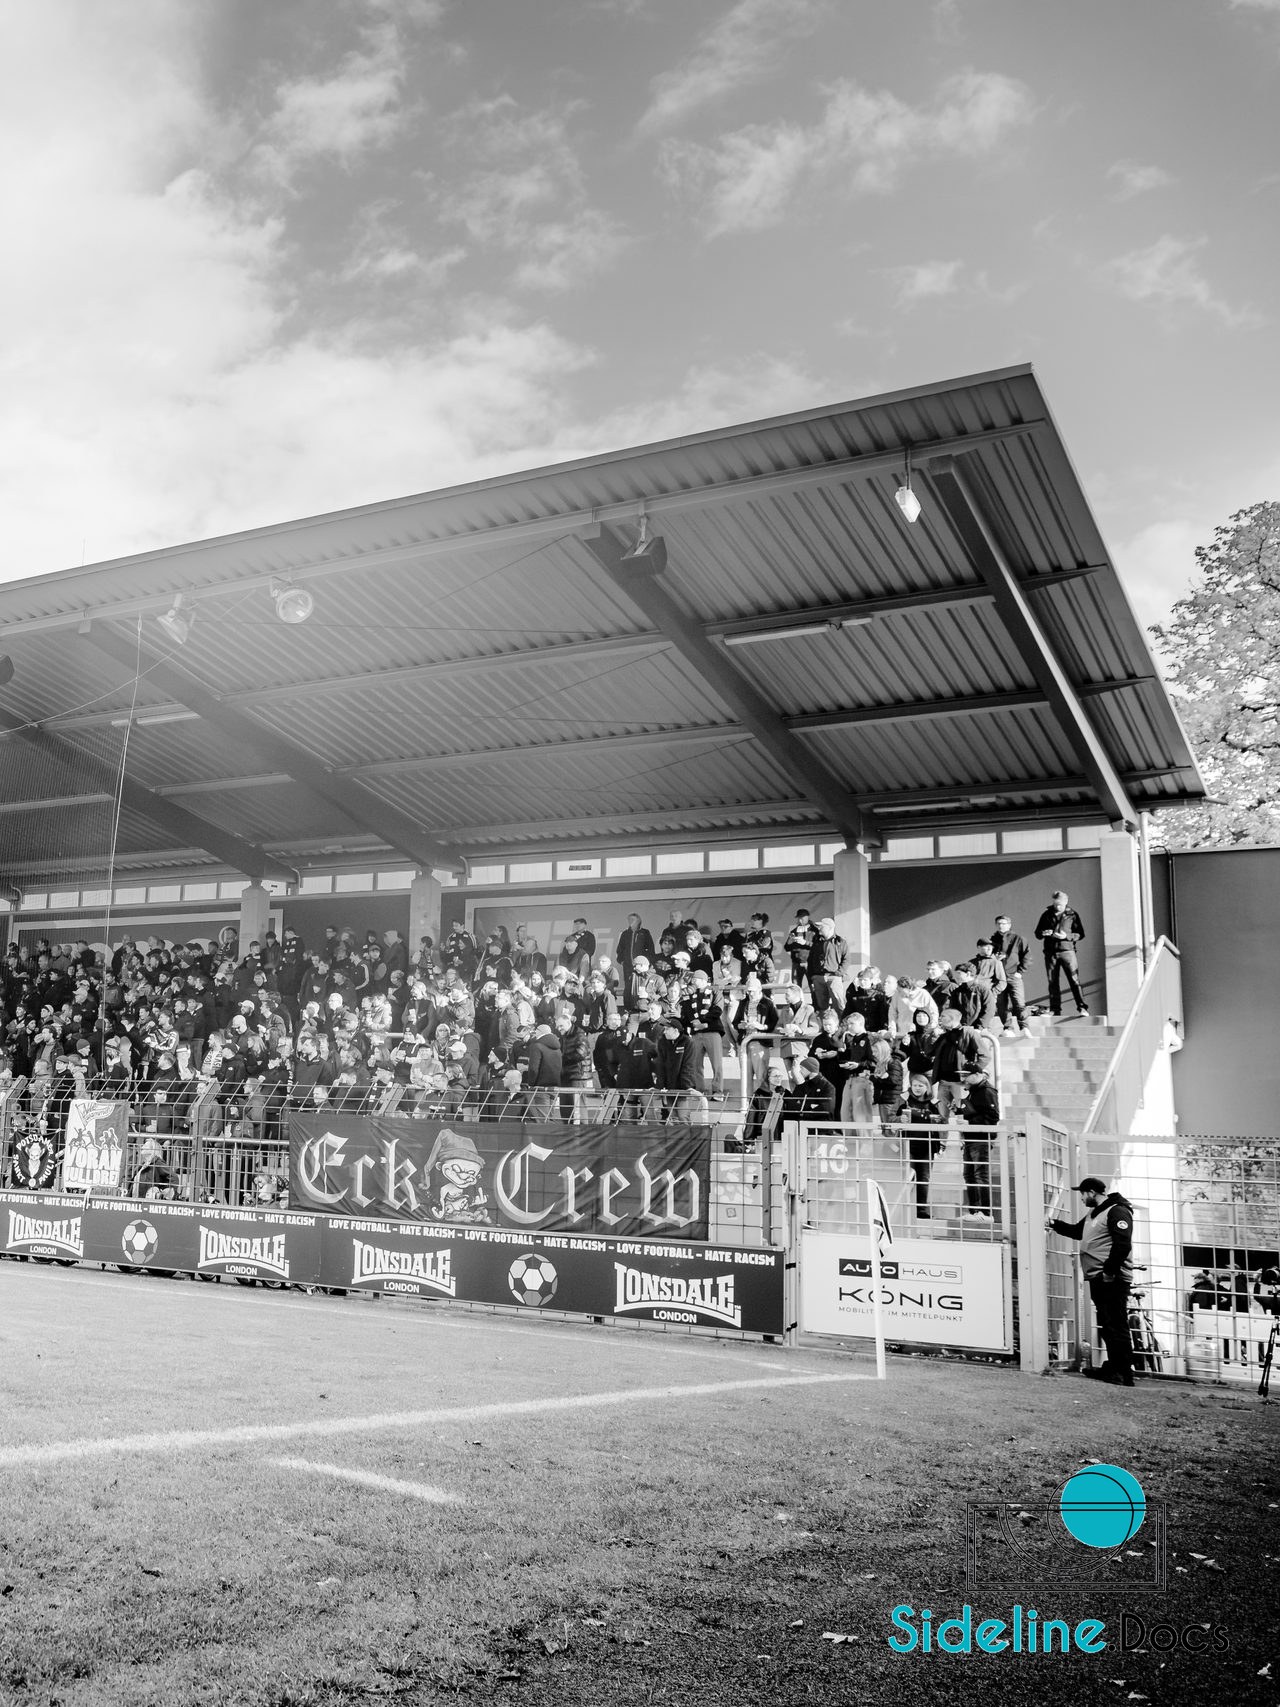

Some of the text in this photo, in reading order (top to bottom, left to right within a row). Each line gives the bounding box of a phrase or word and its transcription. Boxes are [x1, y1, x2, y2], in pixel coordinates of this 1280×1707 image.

[816, 1143, 850, 1174] 16
[296, 1131, 701, 1228] Eck Crew
[7, 1194, 38, 1205] FOOTBALL
[44, 1197, 61, 1206] HATE
[92, 1201, 109, 1210] LOVE
[109, 1203, 142, 1213] FOOTBALL
[149, 1206, 167, 1216] HATE
[168, 1207, 194, 1217] RACISM
[201, 1209, 219, 1219] LOVE
[221, 1210, 257, 1222] FOOTBALL
[264, 1215, 284, 1225] HATE
[286, 1216, 315, 1227] RACISM
[6, 1209, 84, 1250] LONSDALE
[329, 1219, 349, 1230] LOVE
[350, 1220, 391, 1234] FOOTBALL
[400, 1225, 422, 1236] HATE
[423, 1226, 455, 1239] RACISM
[464, 1230, 487, 1242] LOVE
[489, 1232, 534, 1246] FOOTBALL
[543, 1236, 568, 1249] HATE
[570, 1238, 606, 1251] RACISM
[616, 1242, 642, 1255] LOVE
[643, 1244, 694, 1260] FOOTBALL
[704, 1250, 732, 1263] HATE
[734, 1252, 775, 1266] RACISM
[30, 1245, 57, 1255] LONDON
[198, 1225, 287, 1271] LONSDALE
[352, 1238, 453, 1287] LONSDALE
[225, 1264, 257, 1276] LONDON
[902, 1267, 958, 1279] HAUS
[383, 1281, 420, 1293] LONDON
[614, 1261, 738, 1317] LONSDALE
[653, 1309, 697, 1324] LONDON
[838, 1306, 885, 1316] MOBILIT
[901, 1311, 963, 1322] MITTELPUNKT
